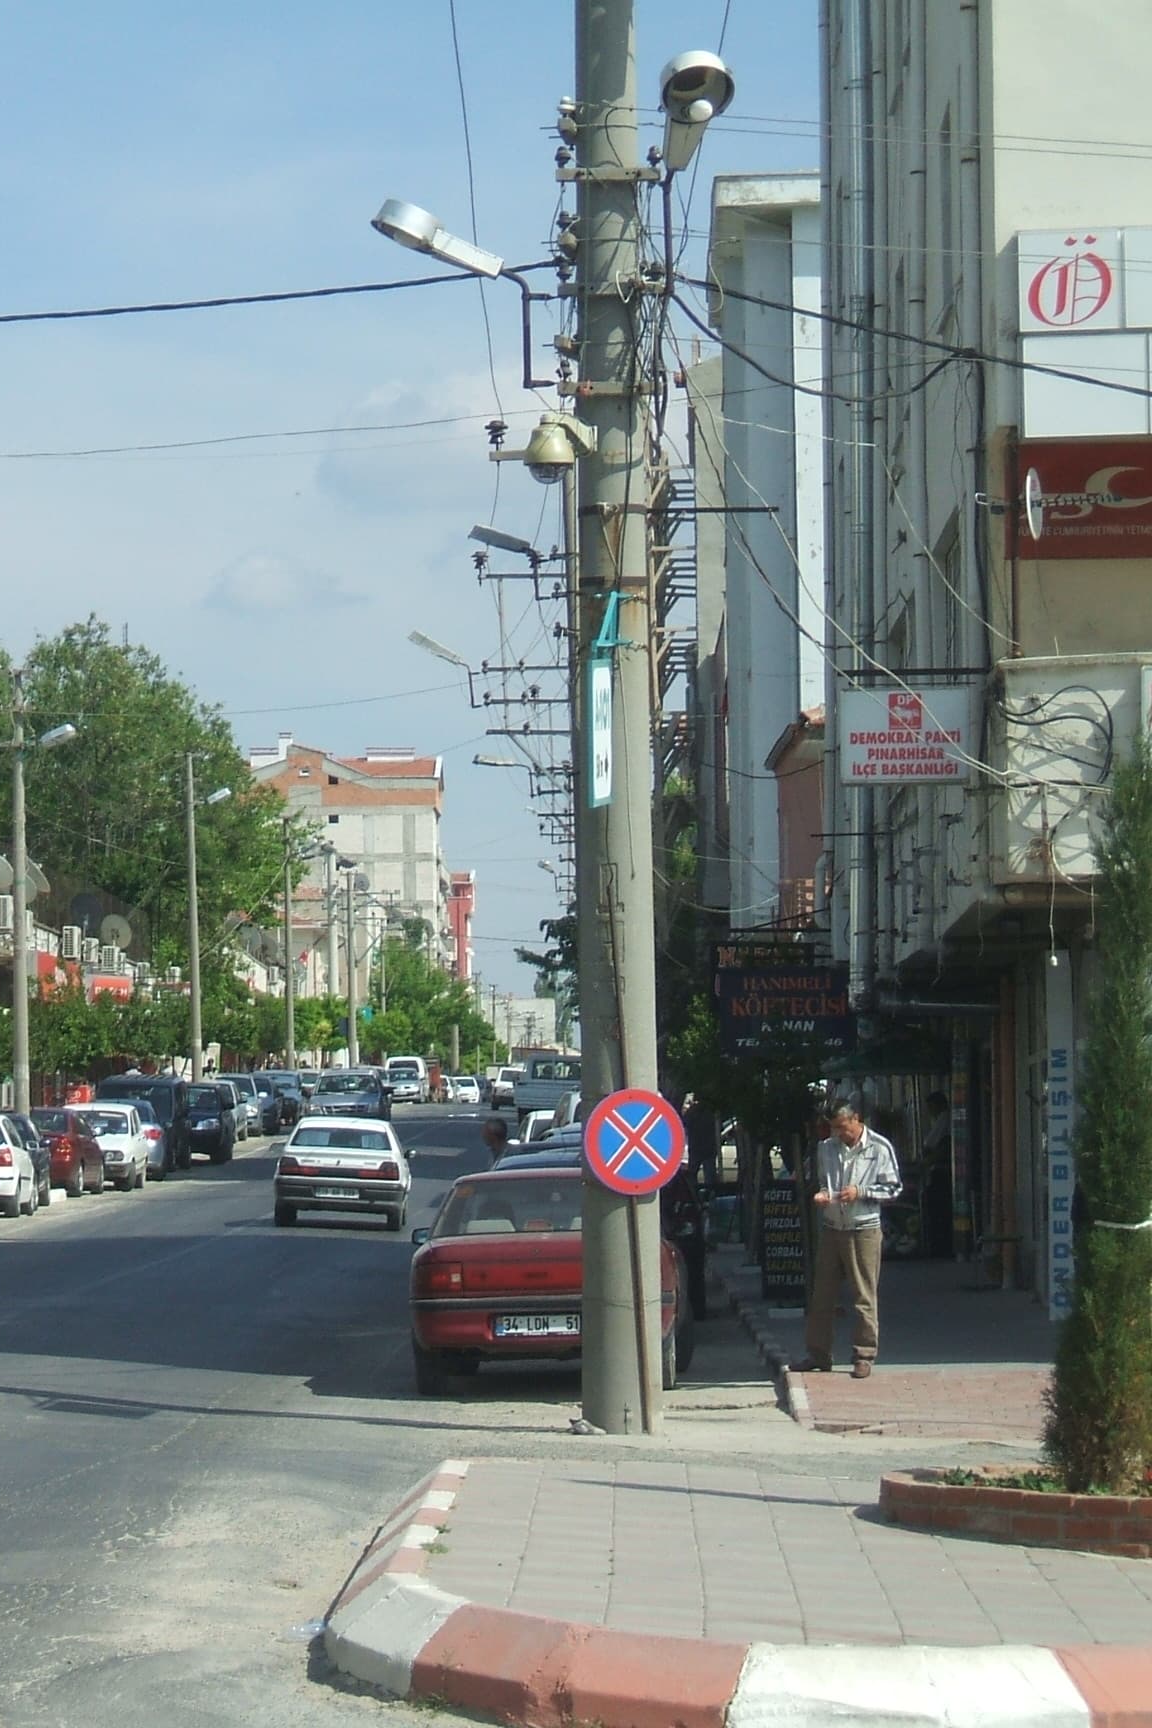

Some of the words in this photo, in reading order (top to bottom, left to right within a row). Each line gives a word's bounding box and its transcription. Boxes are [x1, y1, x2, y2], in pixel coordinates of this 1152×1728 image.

[850, 731, 921, 745] DEMOKRAT
[924, 728, 961, 744] PARTİ
[852, 761, 877, 779] İLÇE
[882, 761, 959, 779] BAŞKANLIĞI
[504, 1318, 519, 1331] 34
